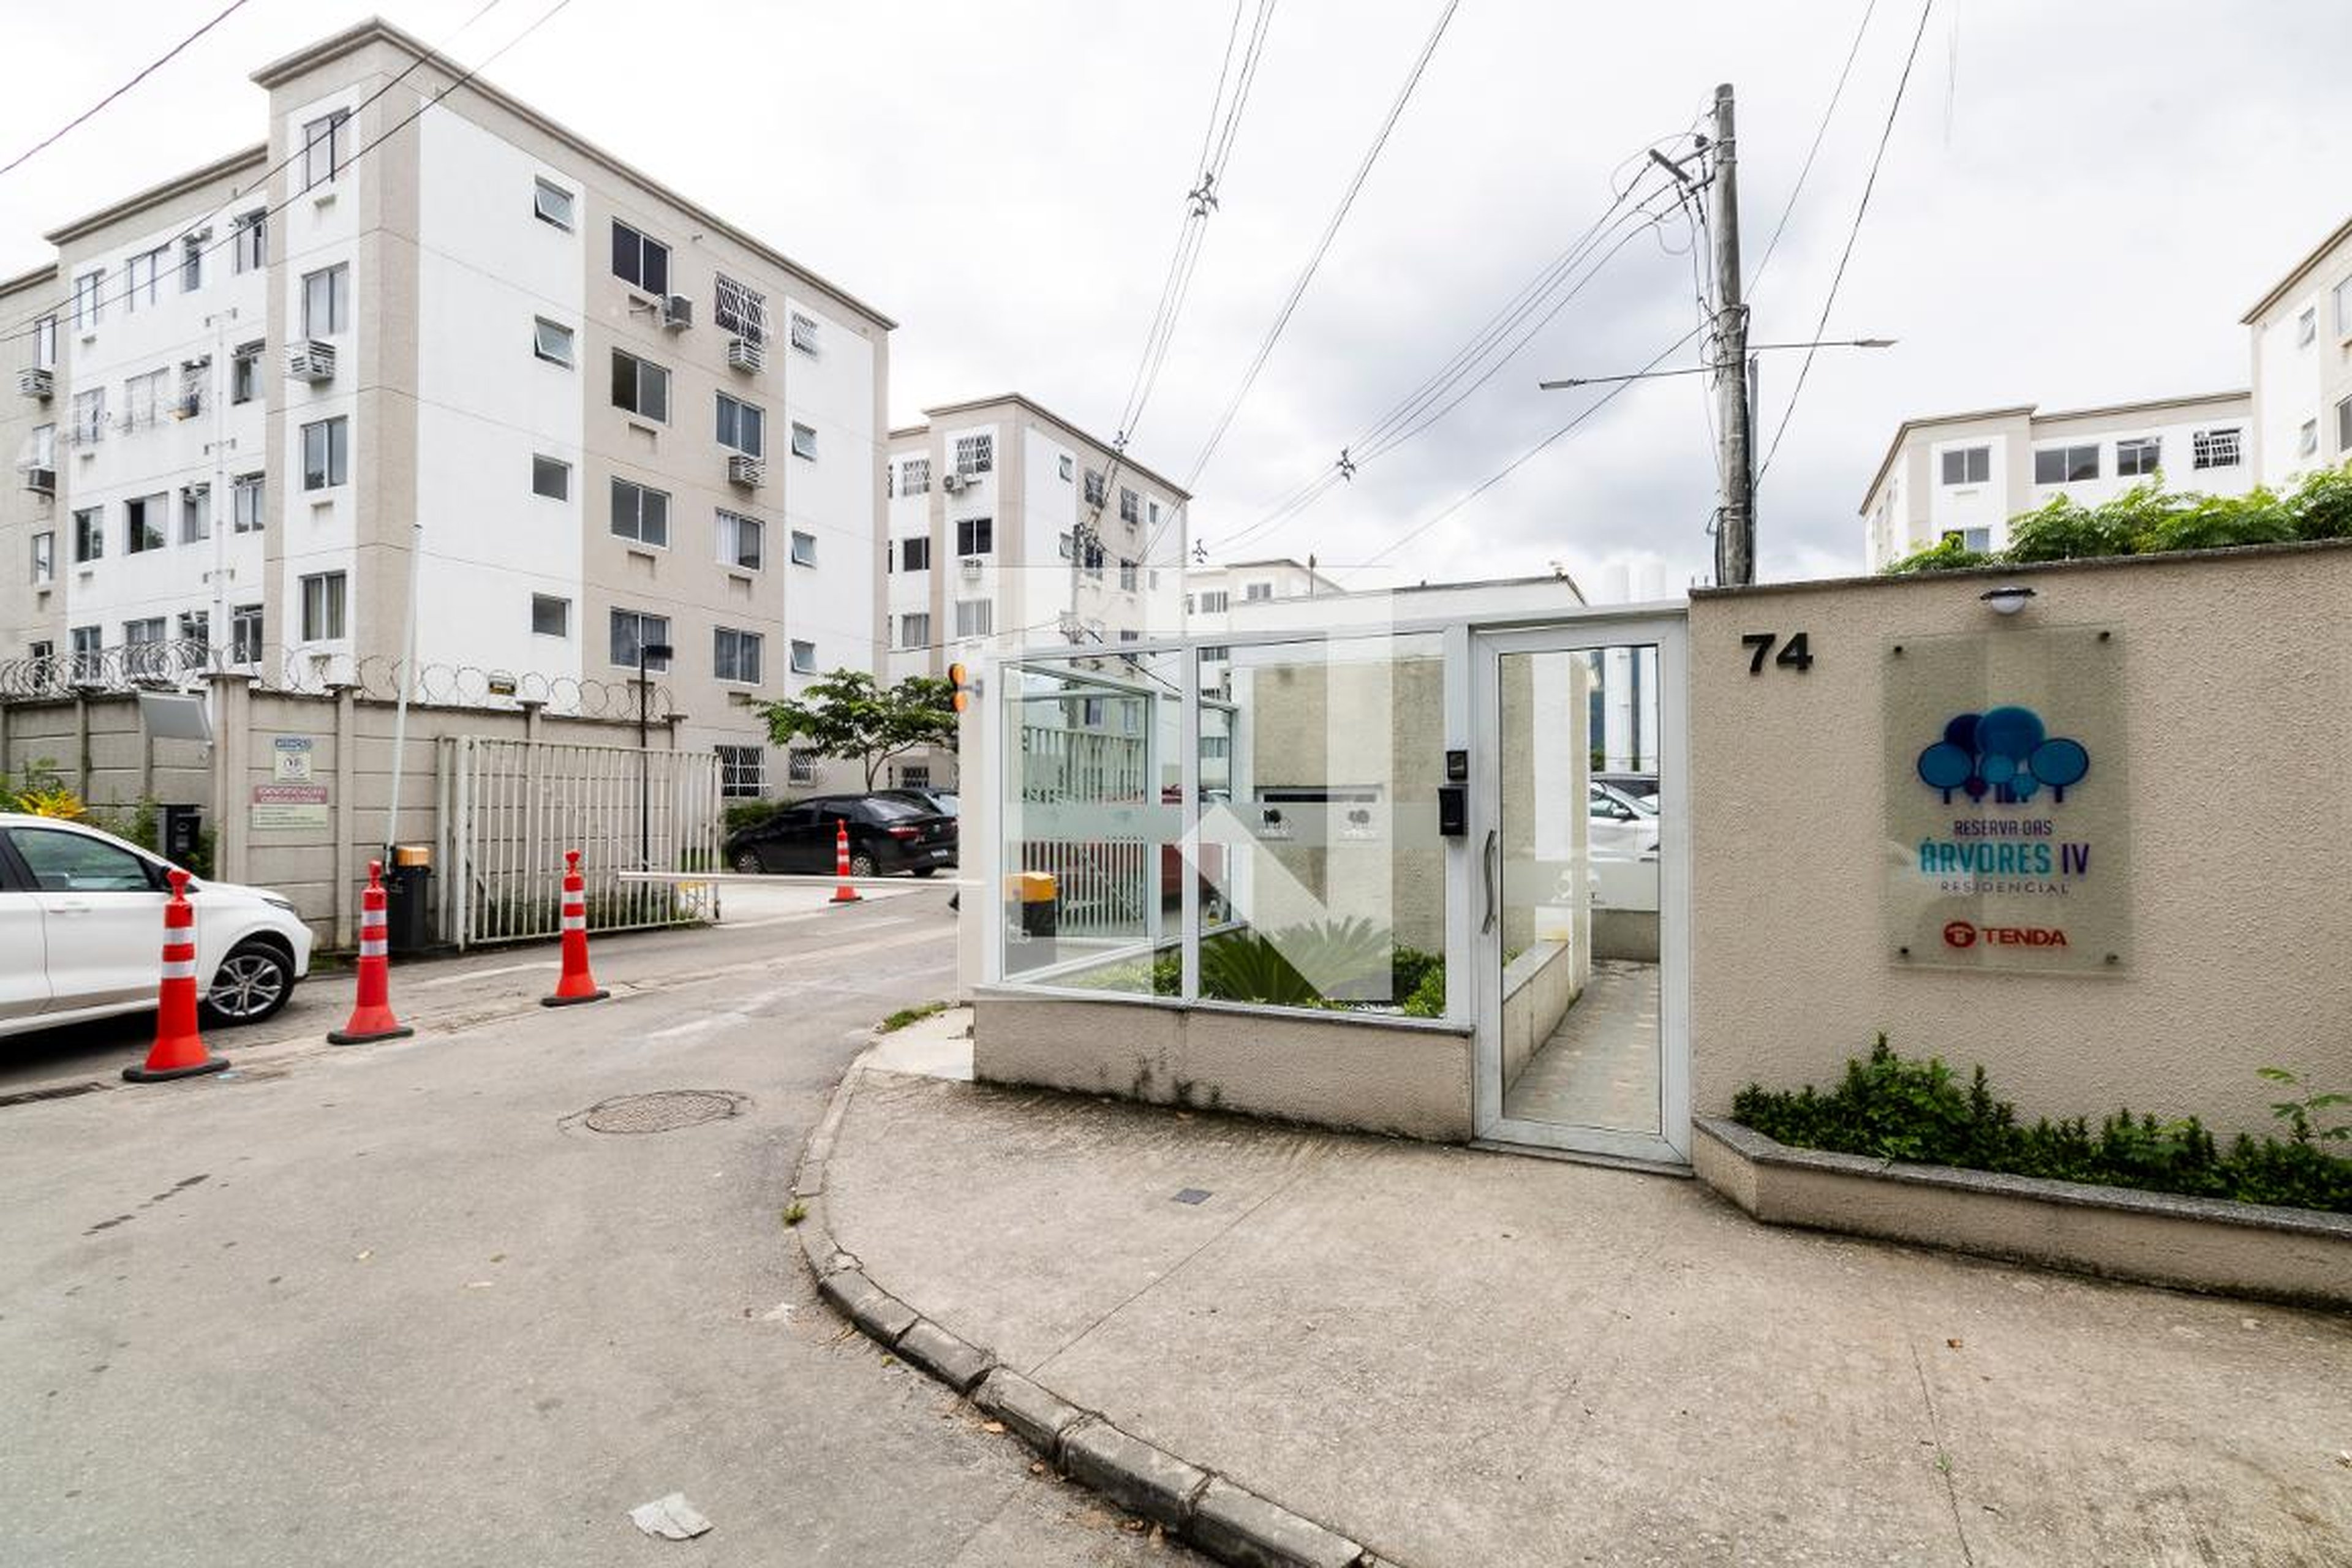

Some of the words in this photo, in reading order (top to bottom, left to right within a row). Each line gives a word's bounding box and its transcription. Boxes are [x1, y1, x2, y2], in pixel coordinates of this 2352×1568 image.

[1742, 632, 1813, 673] 74
[1954, 820, 2018, 835] RESERVA
[2022, 820, 2053, 835] DAS
[1920, 837, 2051, 874] ÁRVORES
[2061, 843, 2090, 875] IV
[1940, 881, 2069, 894] RESIDENCIAL
[1981, 929, 2067, 946] TENDA
